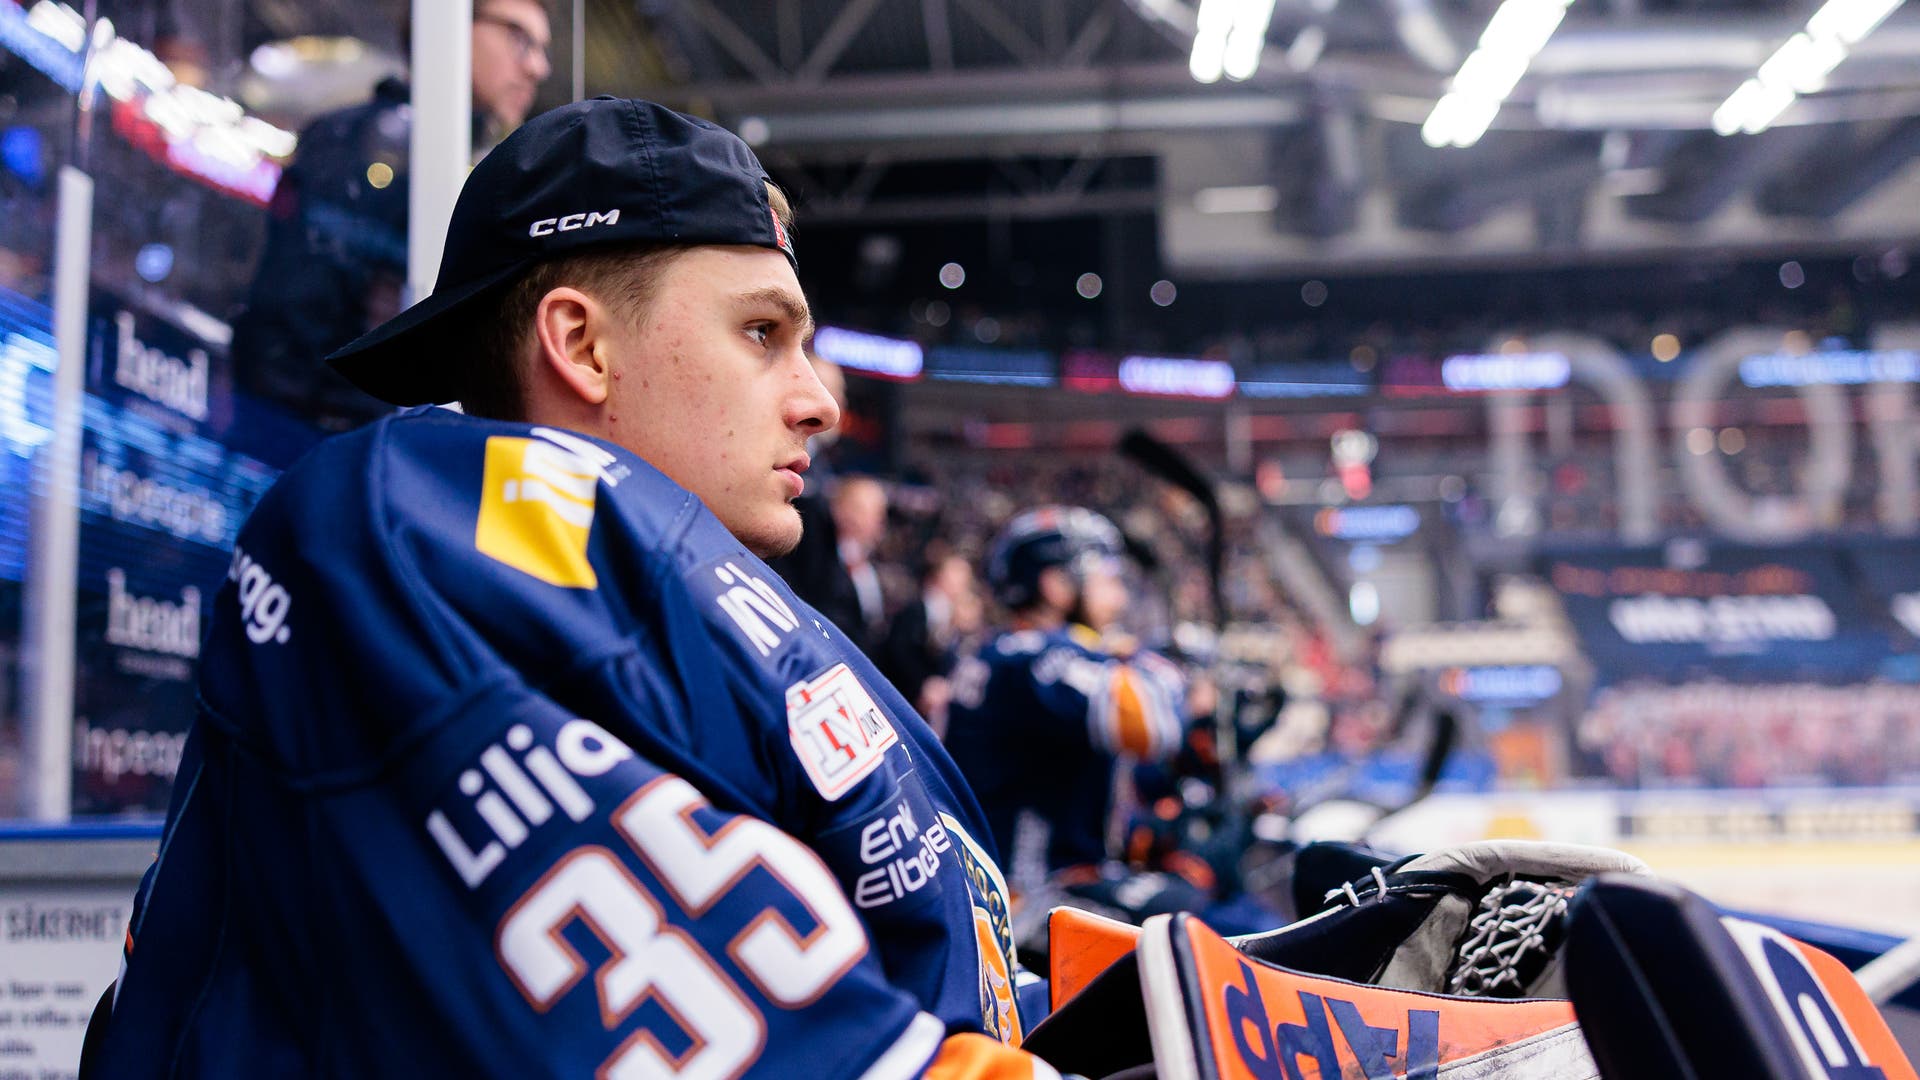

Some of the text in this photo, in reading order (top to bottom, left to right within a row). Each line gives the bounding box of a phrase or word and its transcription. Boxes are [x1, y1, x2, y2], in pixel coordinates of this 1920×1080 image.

[528, 208, 620, 238] CCM
[116, 311, 209, 422] head
[106, 566, 201, 659] head
[426, 718, 635, 890] Lilja
[493, 772, 870, 1080] 35
